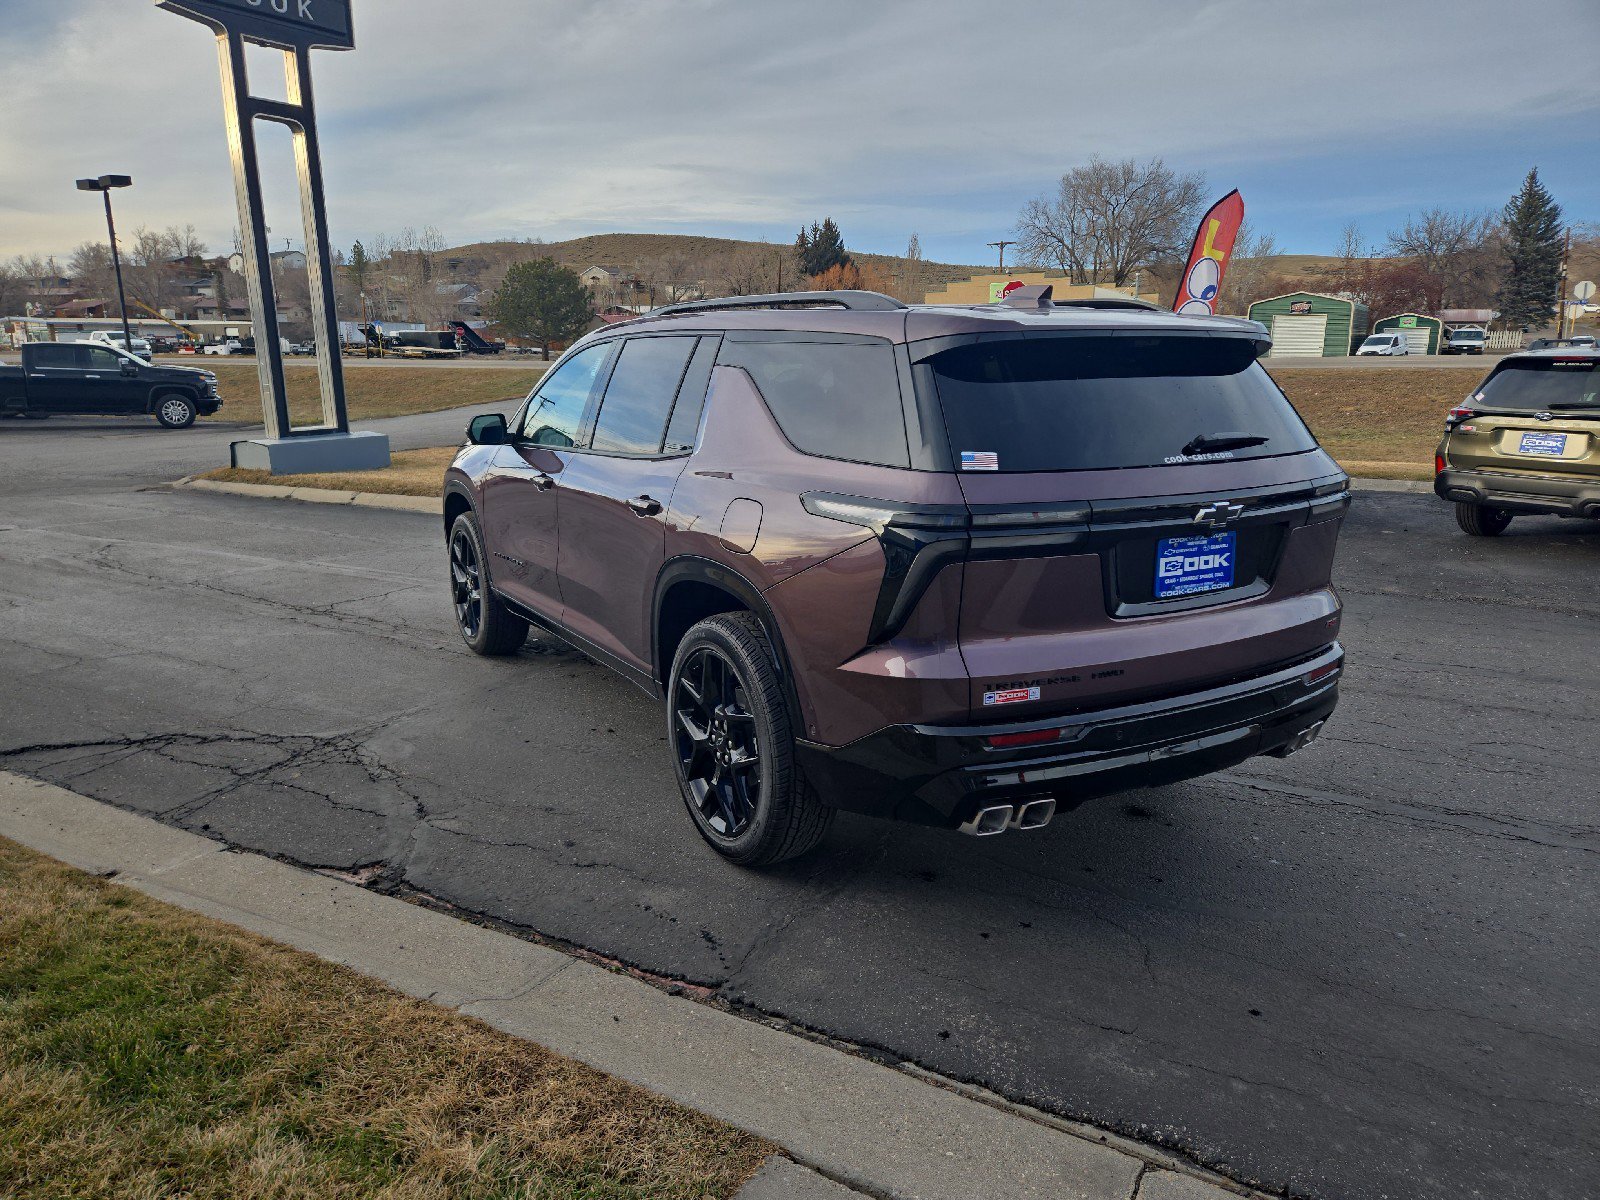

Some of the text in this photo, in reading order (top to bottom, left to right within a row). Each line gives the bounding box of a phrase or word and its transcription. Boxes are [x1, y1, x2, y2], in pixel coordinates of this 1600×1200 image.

[1164, 451, 1234, 464] cook-cars.com
[1159, 553, 1231, 577] COOK
[1160, 582, 1230, 597] COOK-CARS.COM
